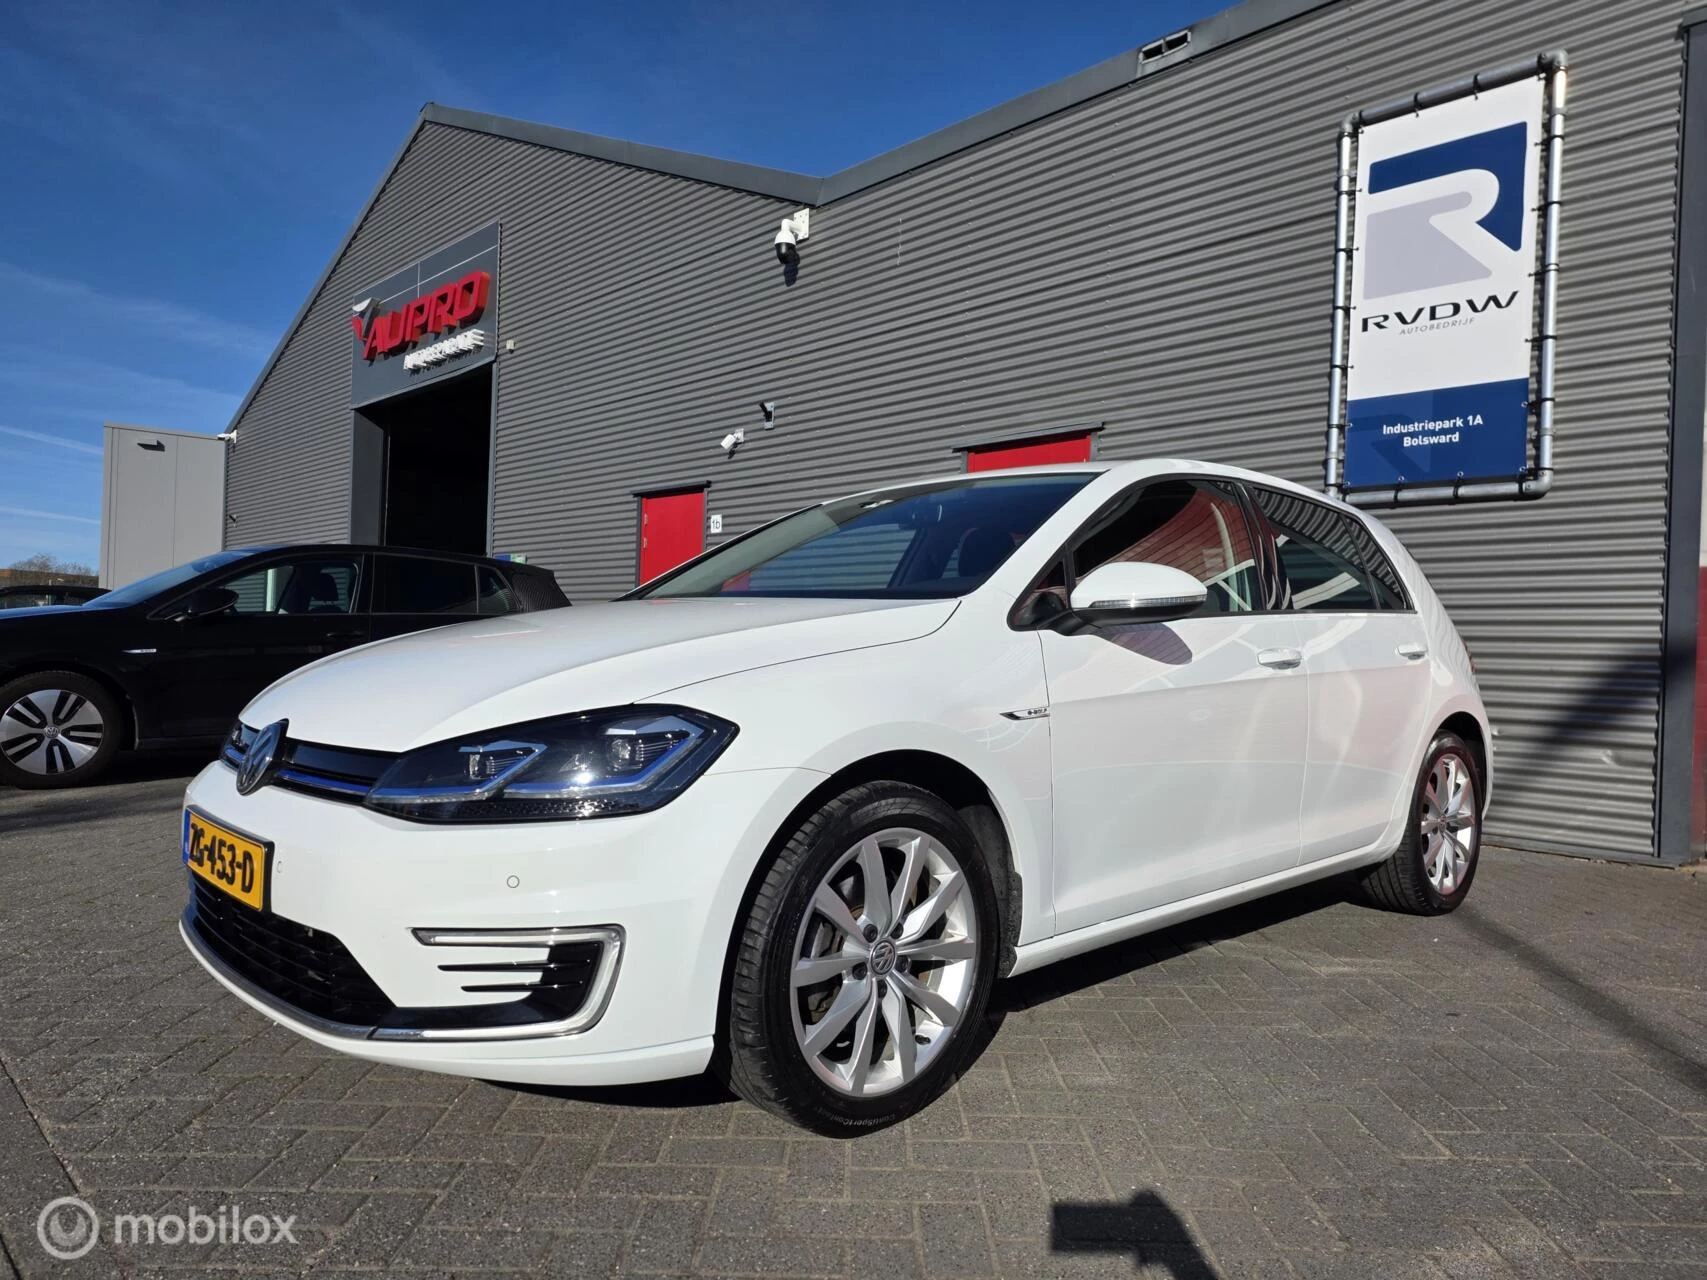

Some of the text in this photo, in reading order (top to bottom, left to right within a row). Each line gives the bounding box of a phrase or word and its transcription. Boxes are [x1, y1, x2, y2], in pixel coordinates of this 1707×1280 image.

[1362, 290, 1519, 333] RVDW
[1400, 317, 1476, 336] AUTOBEDRIJF
[1383, 414, 1484, 435] Industriepark 1A
[1403, 431, 1460, 447] Bolsward
